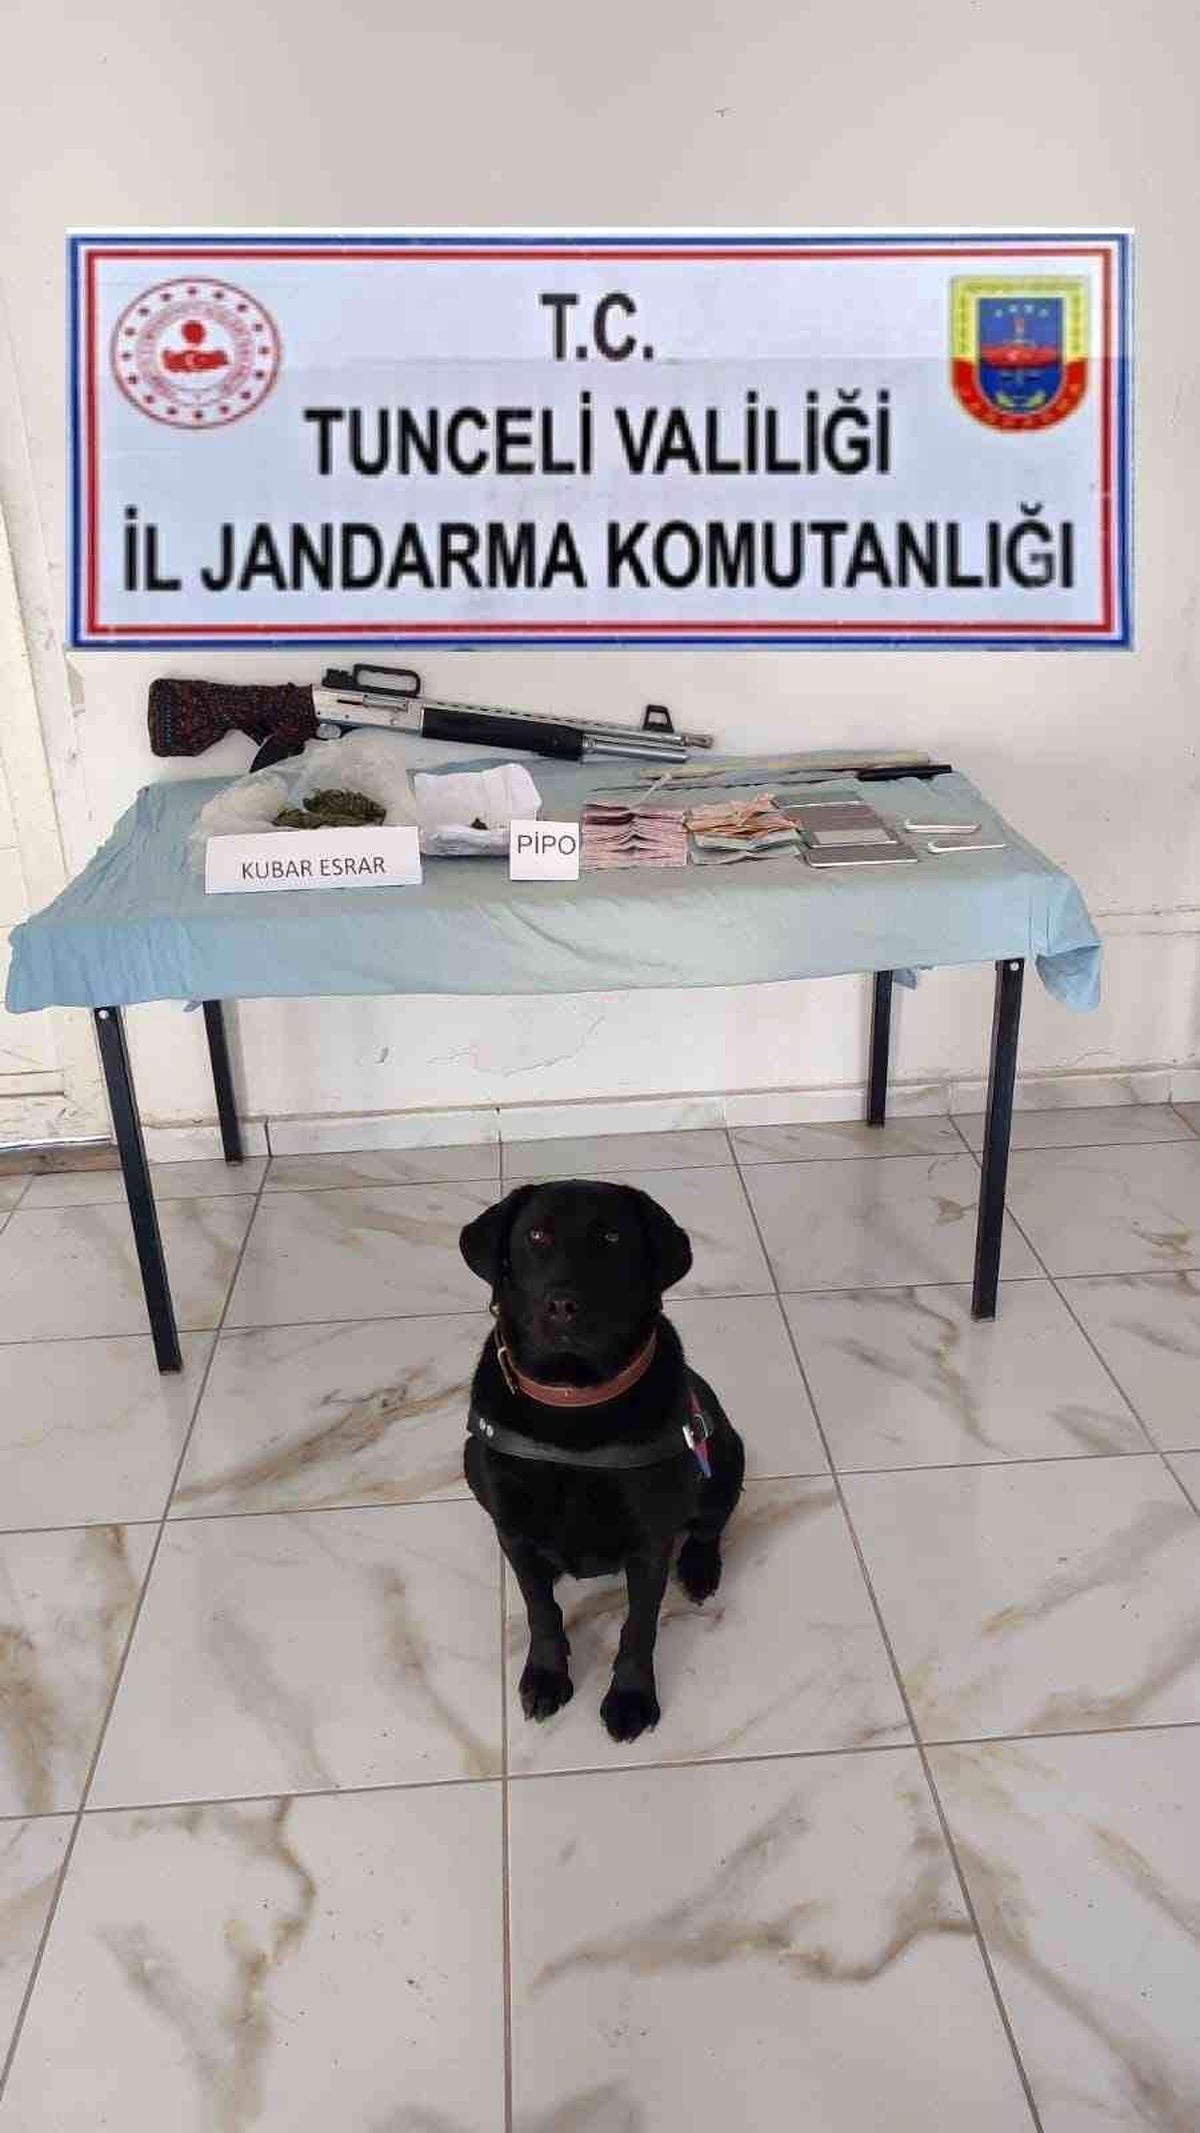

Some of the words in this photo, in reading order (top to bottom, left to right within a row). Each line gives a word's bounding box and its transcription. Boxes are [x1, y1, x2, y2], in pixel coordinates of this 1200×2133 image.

[540, 293, 654, 362] T.C.
[303, 390, 592, 476] TUNCELİ
[614, 388, 891, 475] VALİLİĞİ
[124, 506, 182, 592] İL
[201, 522, 588, 592] JANDARMA
[607, 503, 1074, 589] KOMUTANLIĞI
[241, 859, 312, 881] KUBAR
[319, 856, 386, 878] ESRAR
[516, 831, 577, 856] PİPO
